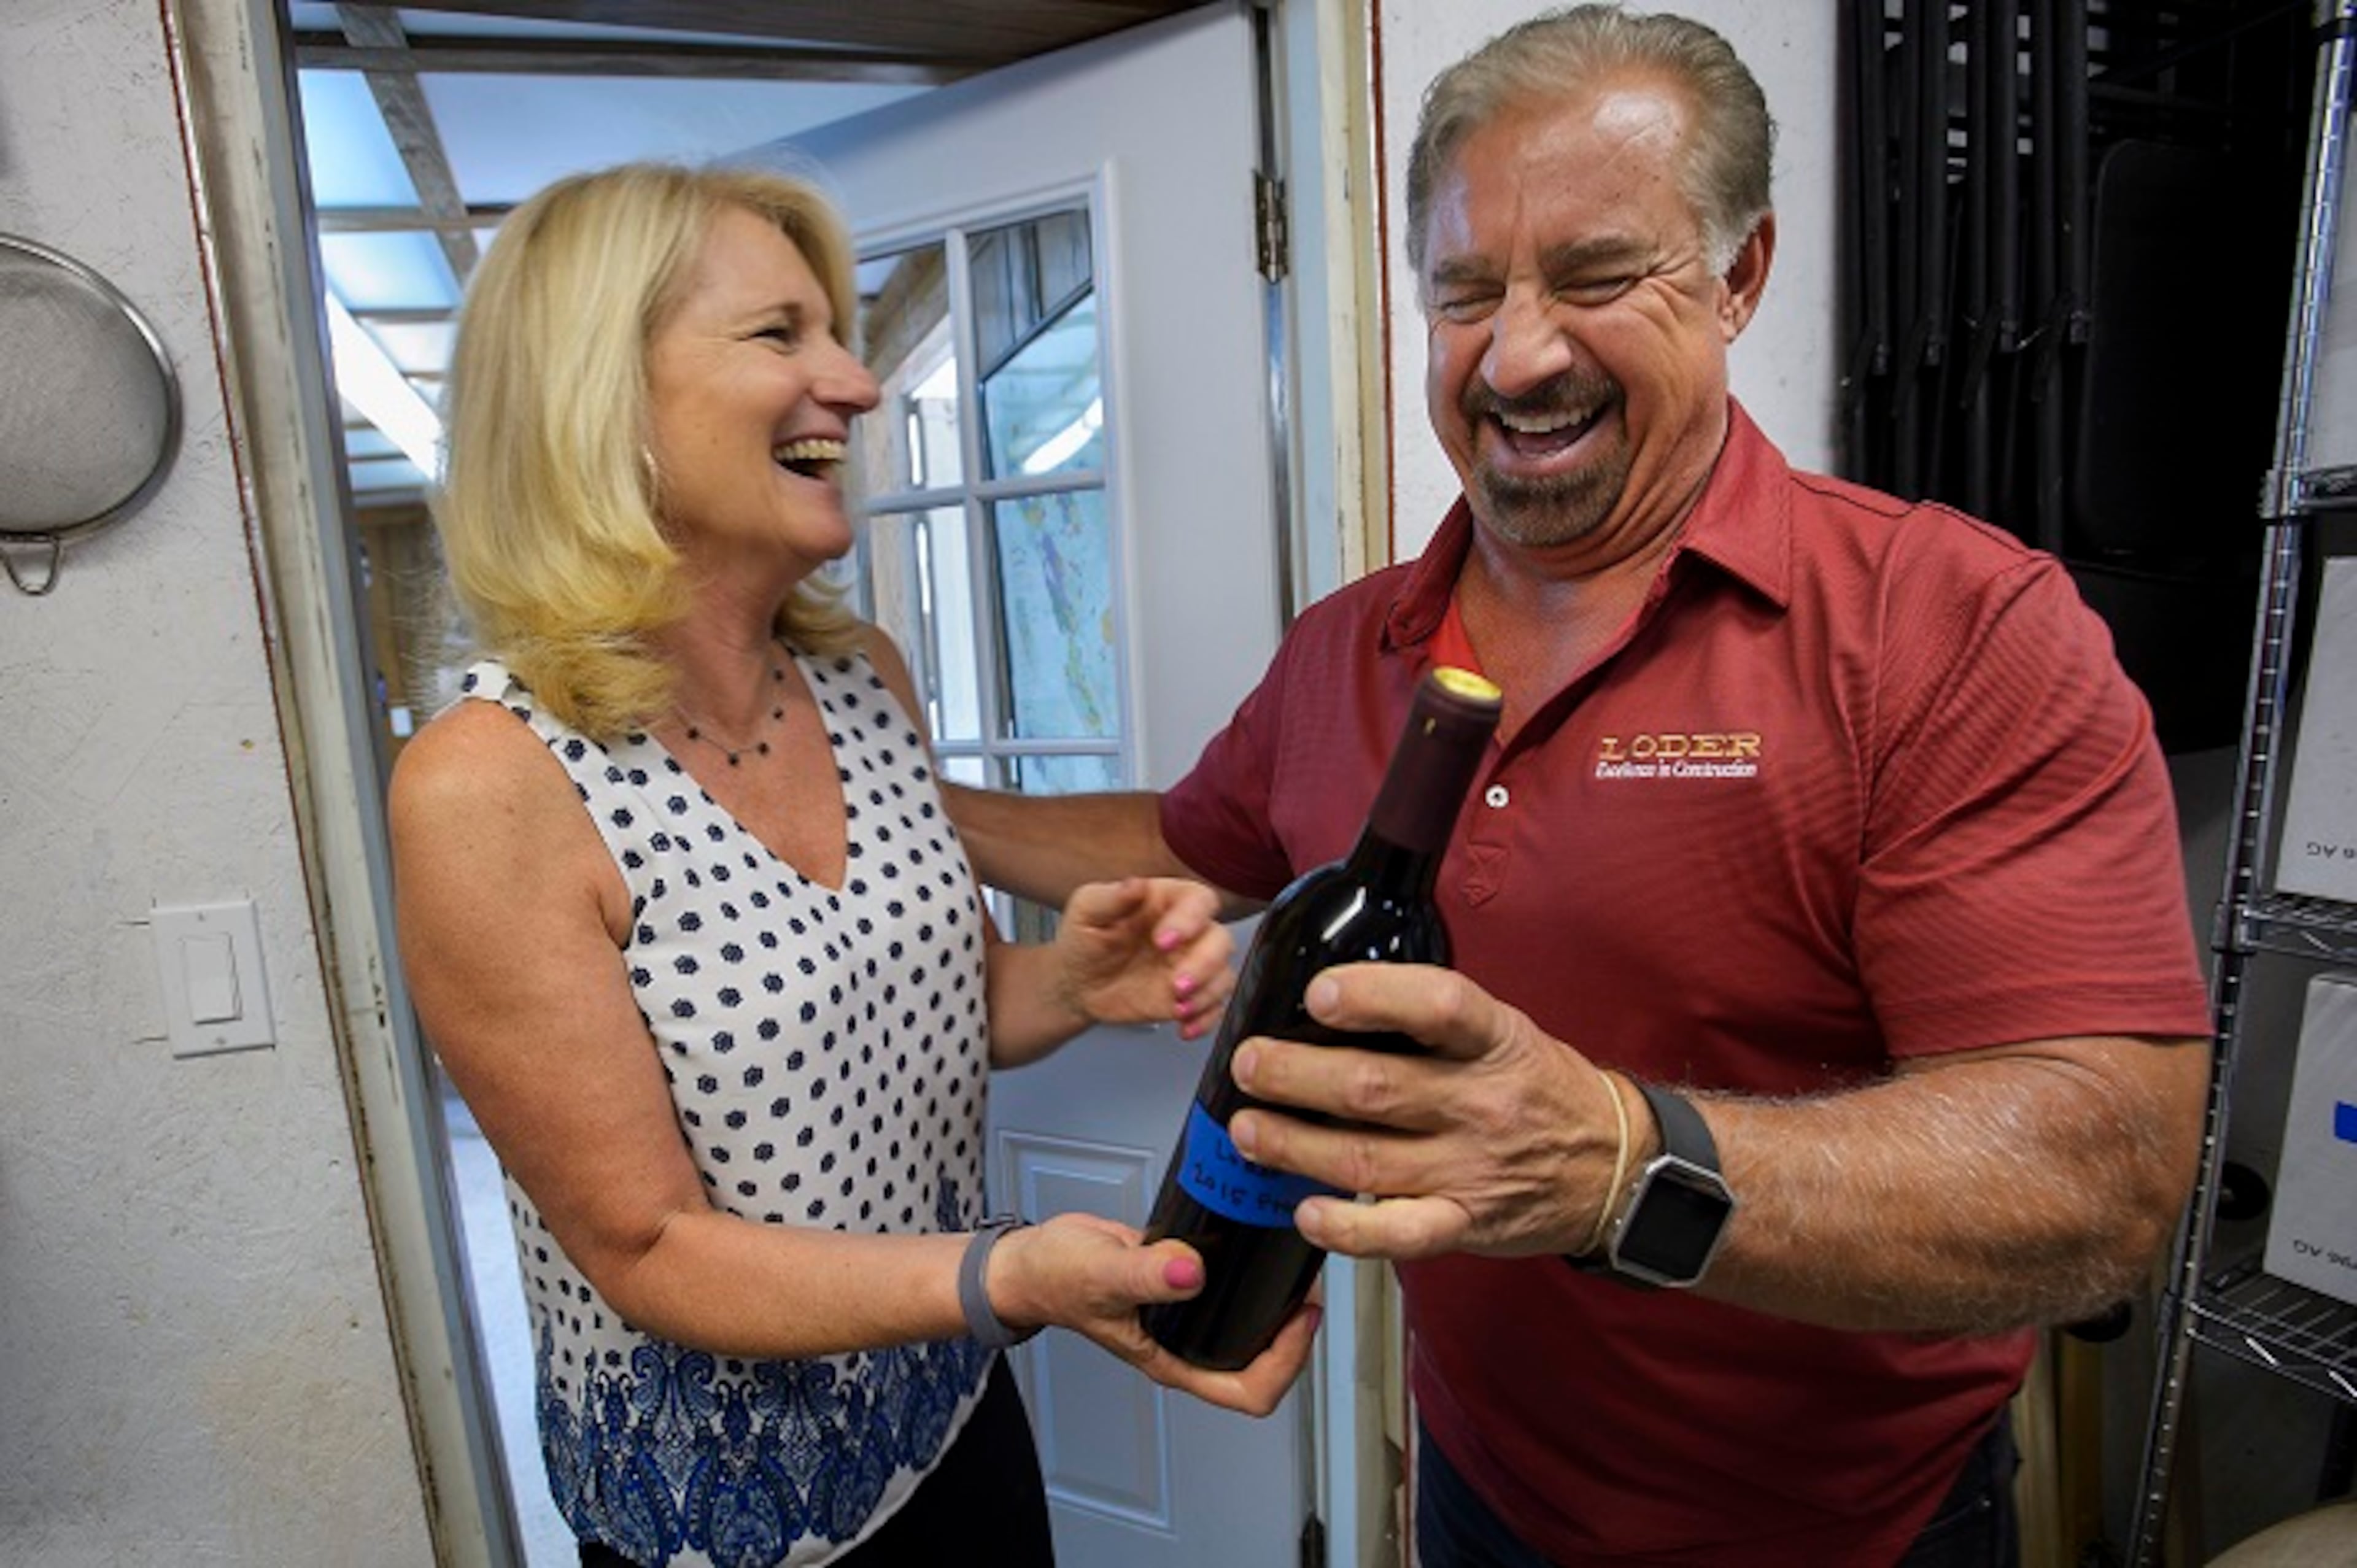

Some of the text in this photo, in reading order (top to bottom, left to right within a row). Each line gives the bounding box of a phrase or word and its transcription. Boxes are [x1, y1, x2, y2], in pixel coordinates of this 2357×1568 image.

[1598, 734, 1762, 760] LODER
[1658, 759, 1671, 778] in
[1672, 759, 1757, 778] Construction
